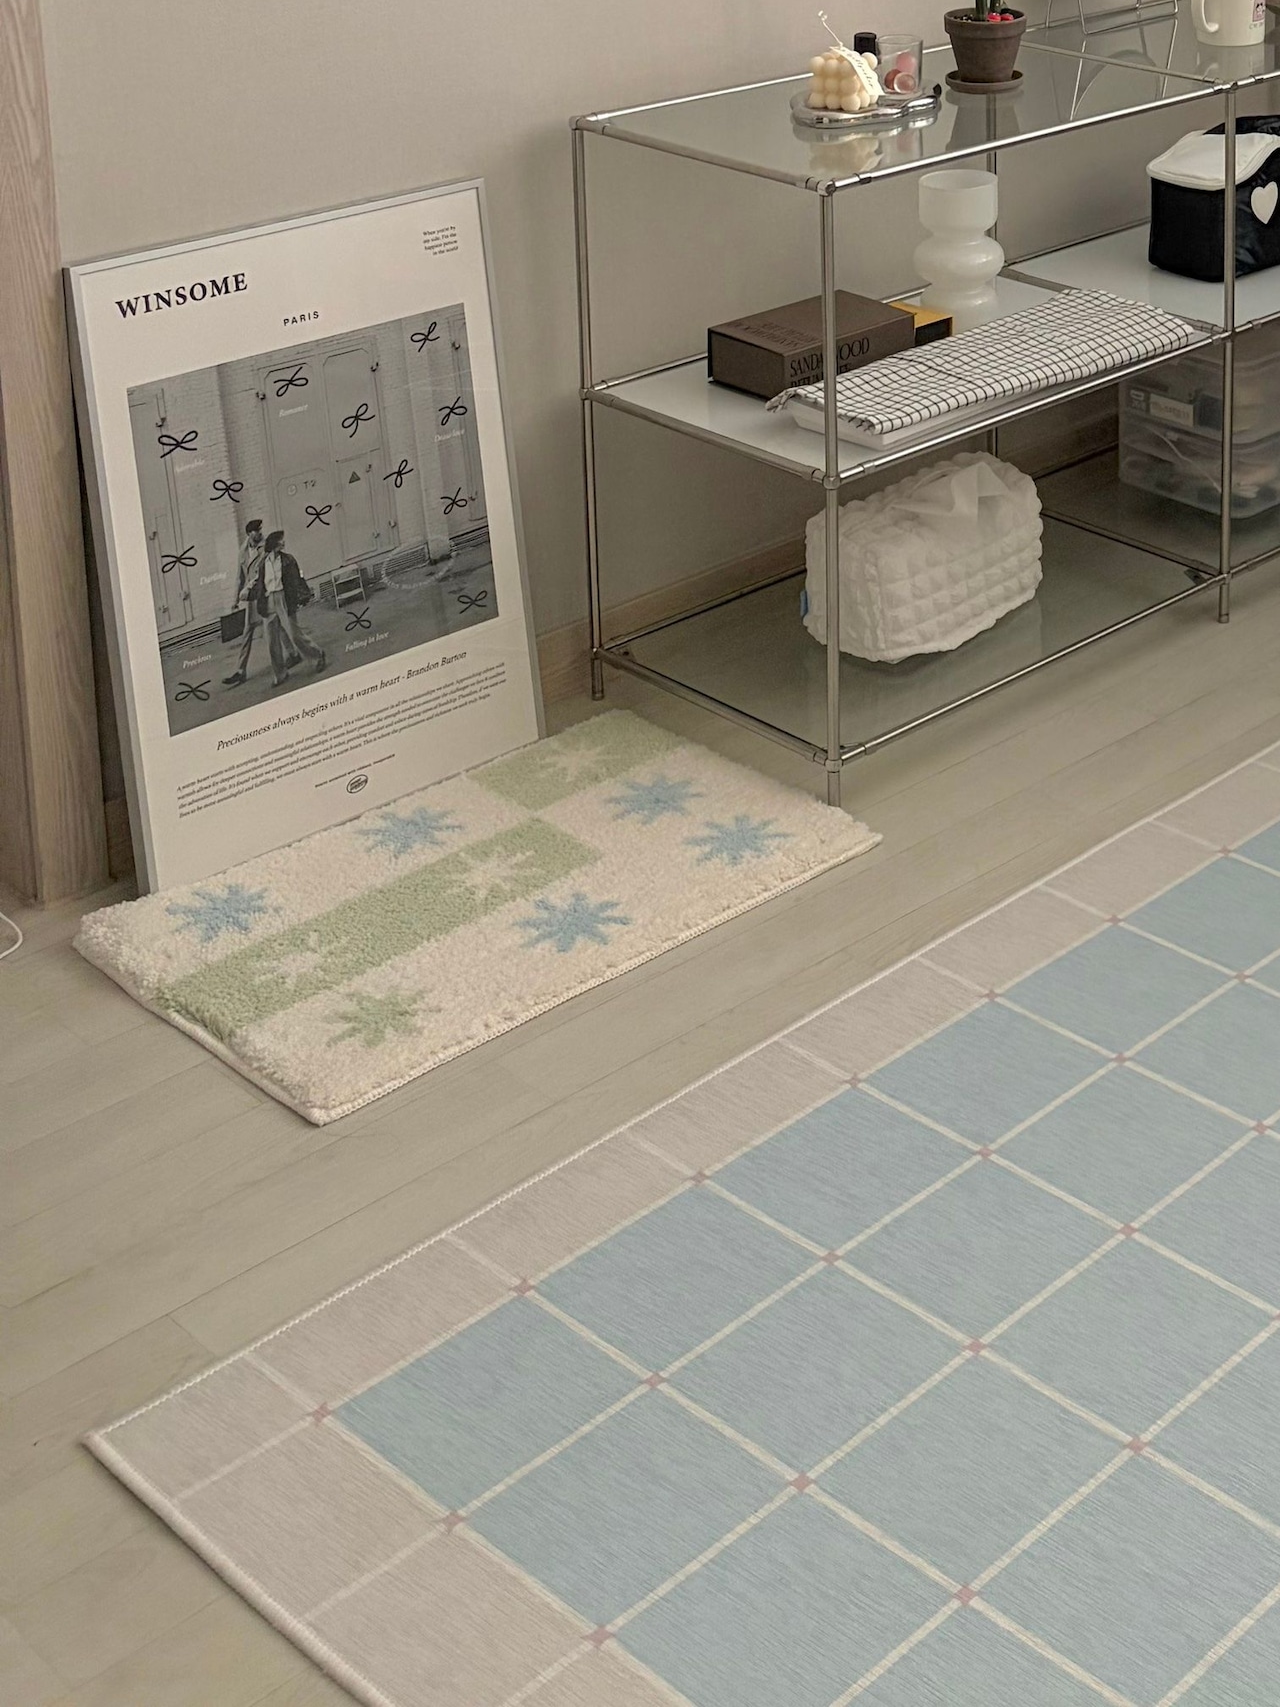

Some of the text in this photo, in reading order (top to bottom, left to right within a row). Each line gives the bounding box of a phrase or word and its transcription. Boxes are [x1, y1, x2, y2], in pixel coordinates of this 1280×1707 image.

[115, 272, 248, 320] WINSOME
[283, 311, 320, 327] PARIS
[790, 337, 870, 377] SANDAOOD
[345, 638, 368, 652] Falling
[217, 724, 271, 750] Preciousness
[272, 713, 300, 728] always
[302, 703, 328, 718] begins
[330, 694, 348, 707] with
[356, 685, 378, 697] warm
[380, 676, 400, 690] heart
[406, 662, 439, 679] Brandon
[440, 652, 467, 666] Burton
